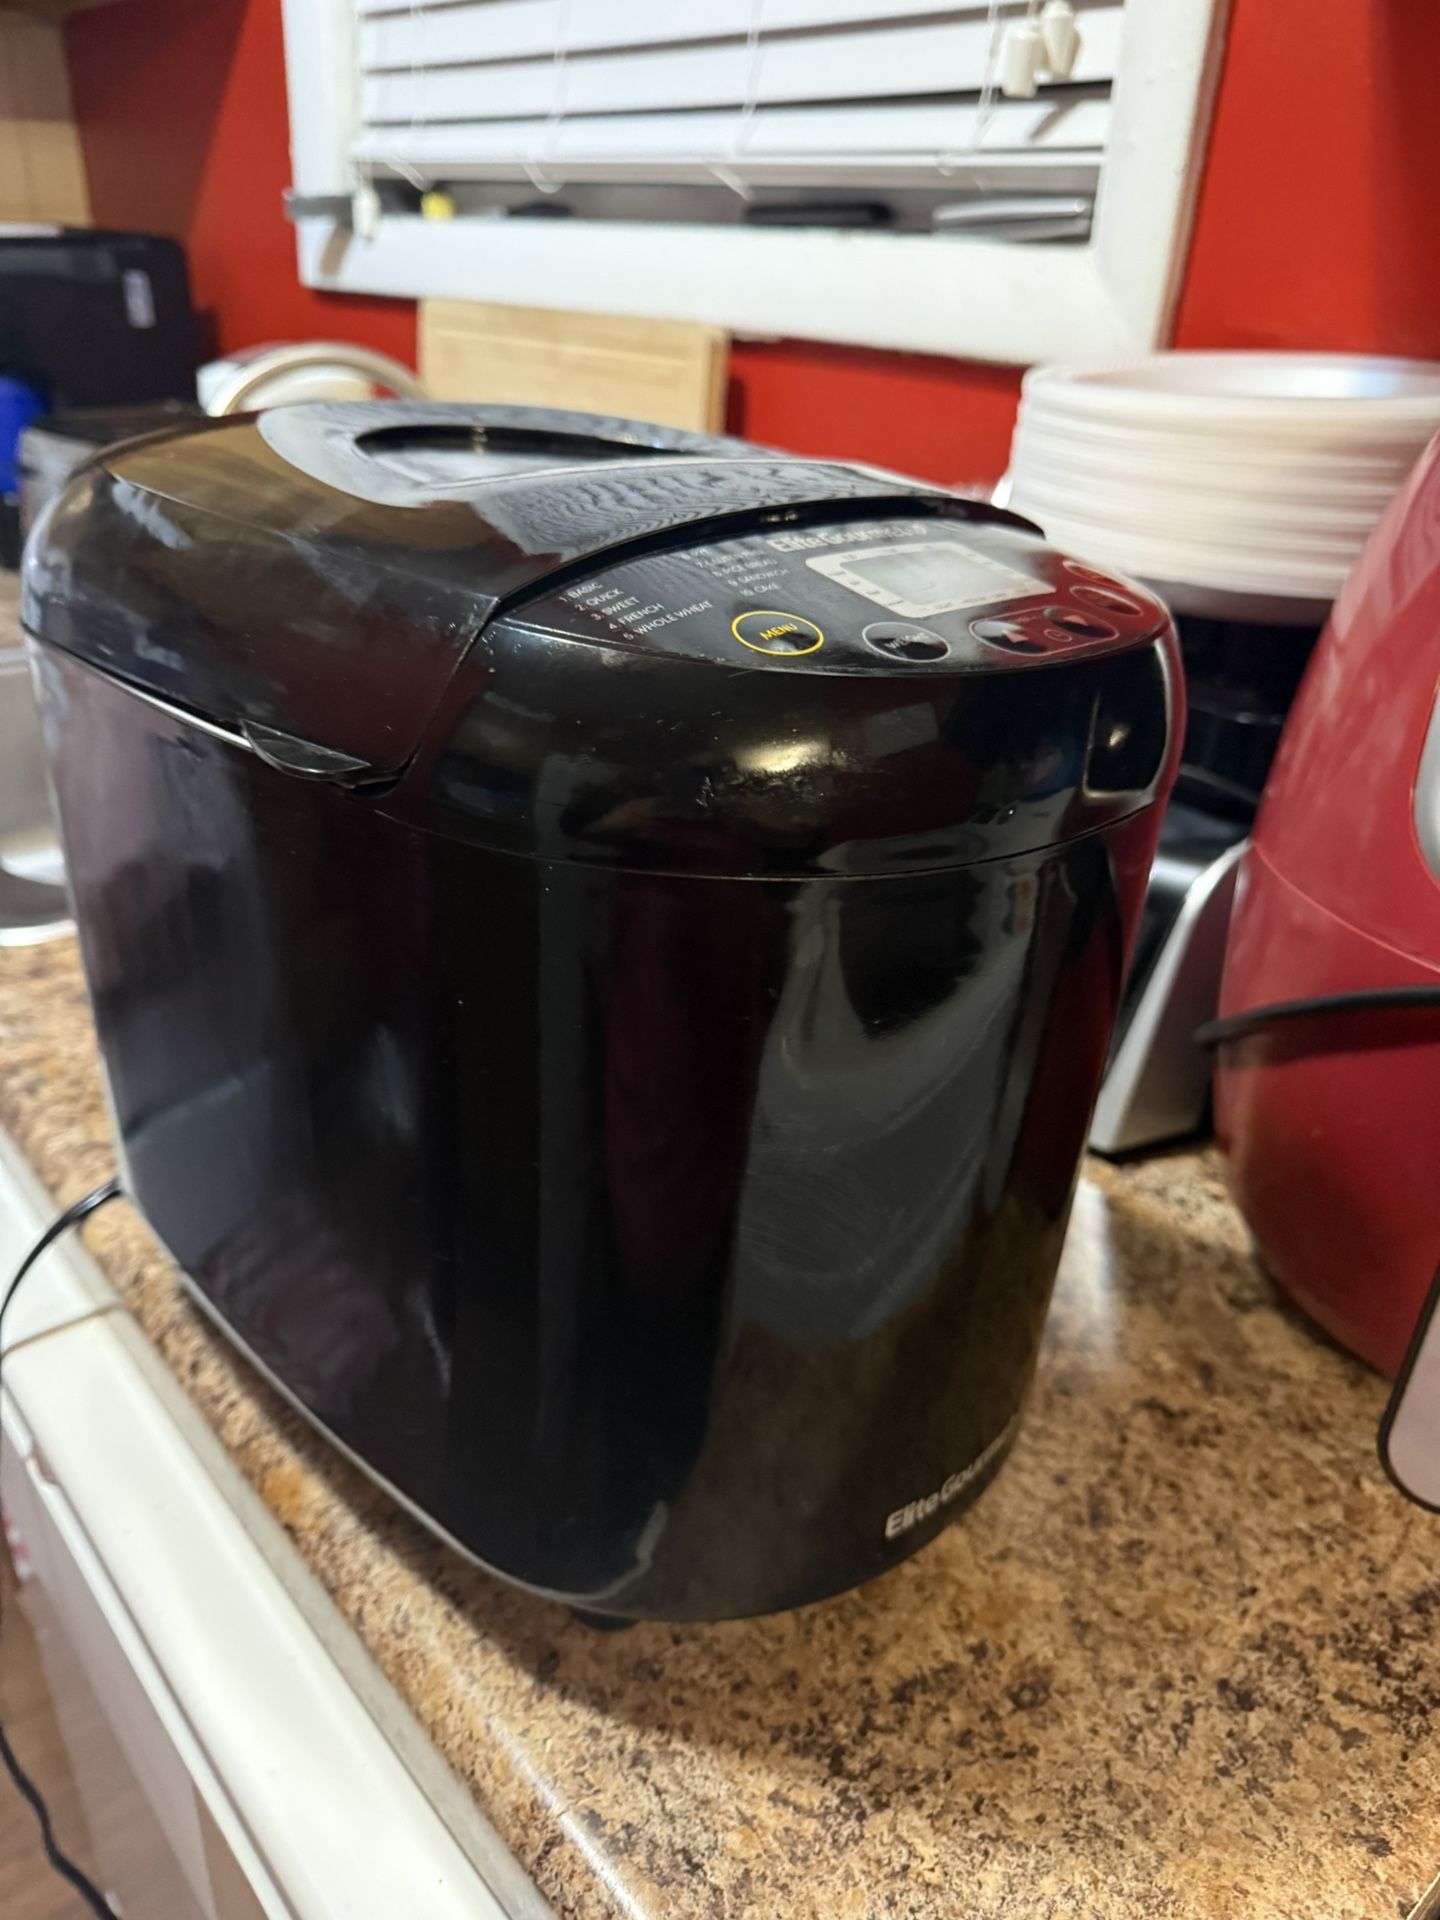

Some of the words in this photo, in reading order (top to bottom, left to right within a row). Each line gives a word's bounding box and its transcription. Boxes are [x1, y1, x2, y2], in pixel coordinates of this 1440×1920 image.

[568, 582, 603, 599] BASIC
[586, 588, 624, 607] QUICK
[601, 596, 640, 616] SWEET
[618, 602, 665, 626] FRENCH
[633, 613, 678, 636] WHOLE
[674, 600, 714, 619] WHEAT
[759, 623, 798, 641] MENU
